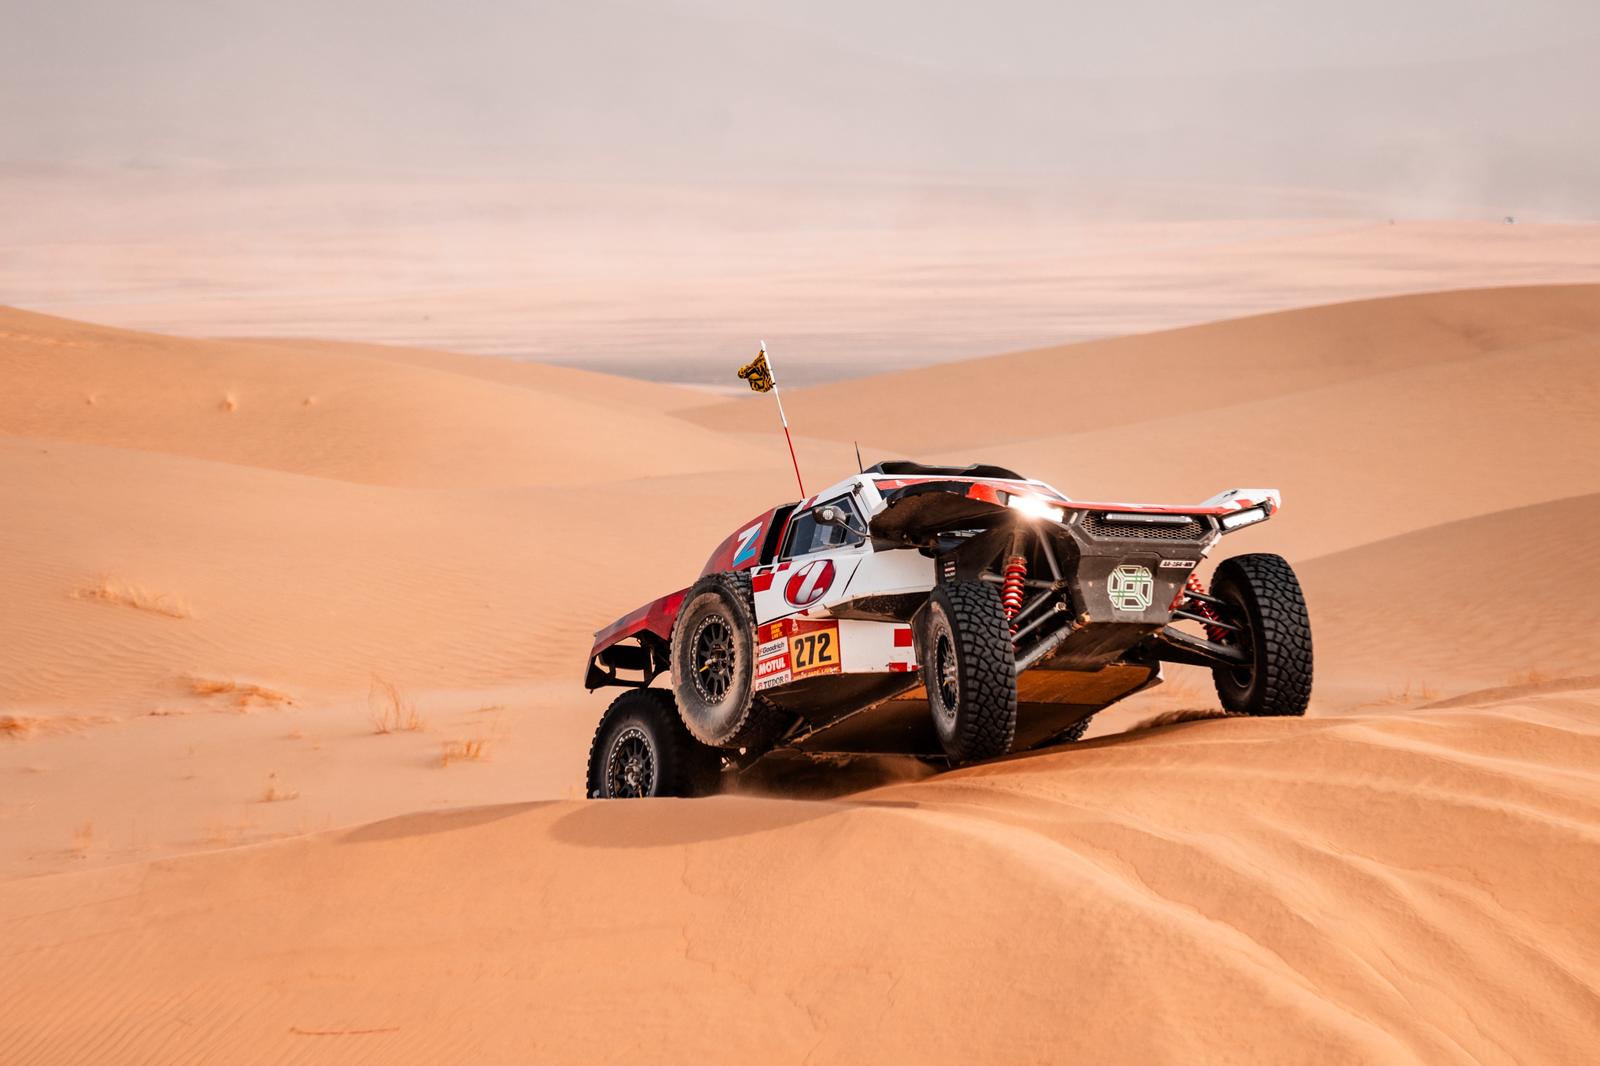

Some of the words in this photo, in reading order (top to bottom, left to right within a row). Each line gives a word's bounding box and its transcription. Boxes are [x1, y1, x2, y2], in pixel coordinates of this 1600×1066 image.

[794, 632, 832, 669] 272
[758, 657, 786, 675] MOTUL
[763, 676, 785, 689] TUDOR
